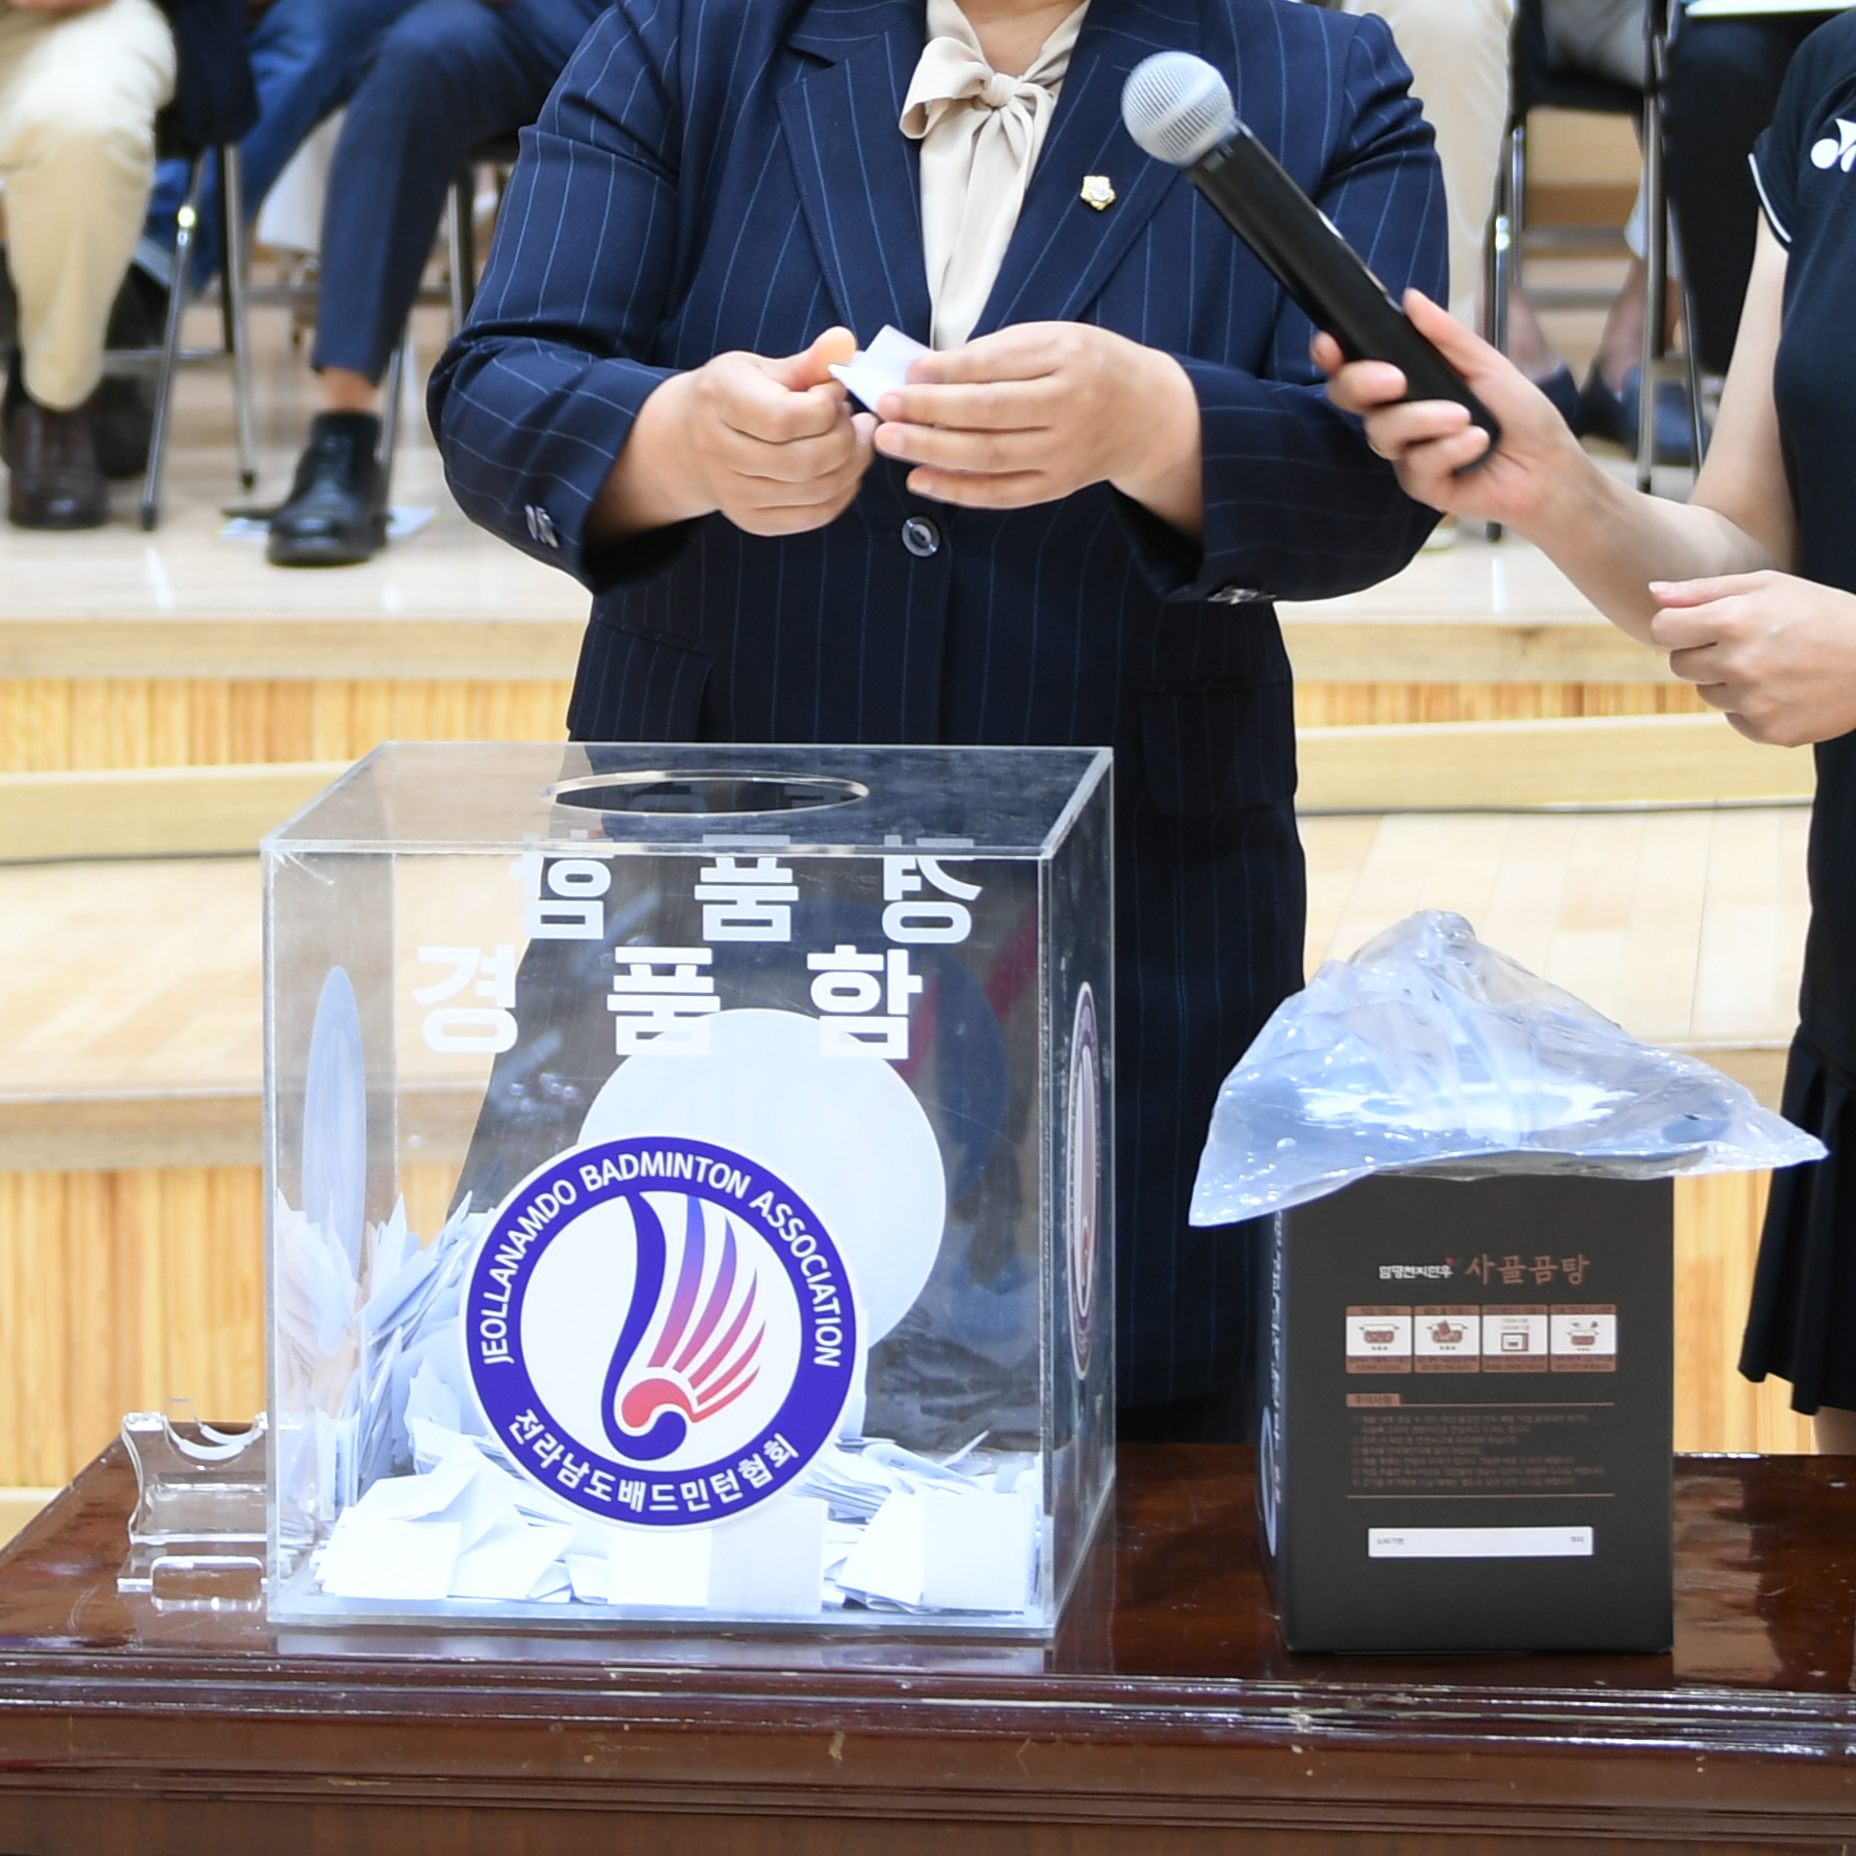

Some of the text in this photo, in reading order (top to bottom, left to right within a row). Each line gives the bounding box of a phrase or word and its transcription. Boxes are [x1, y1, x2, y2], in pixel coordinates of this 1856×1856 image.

[411, 944, 923, 1060] 경품함
[480, 1150, 842, 1367] JEOLLANAMDO BADMINTON ASSOCIATION
[1464, 1253, 1590, 1285] 사골곰탕
[509, 1408, 799, 1513] 전라남도배드민턴협회
